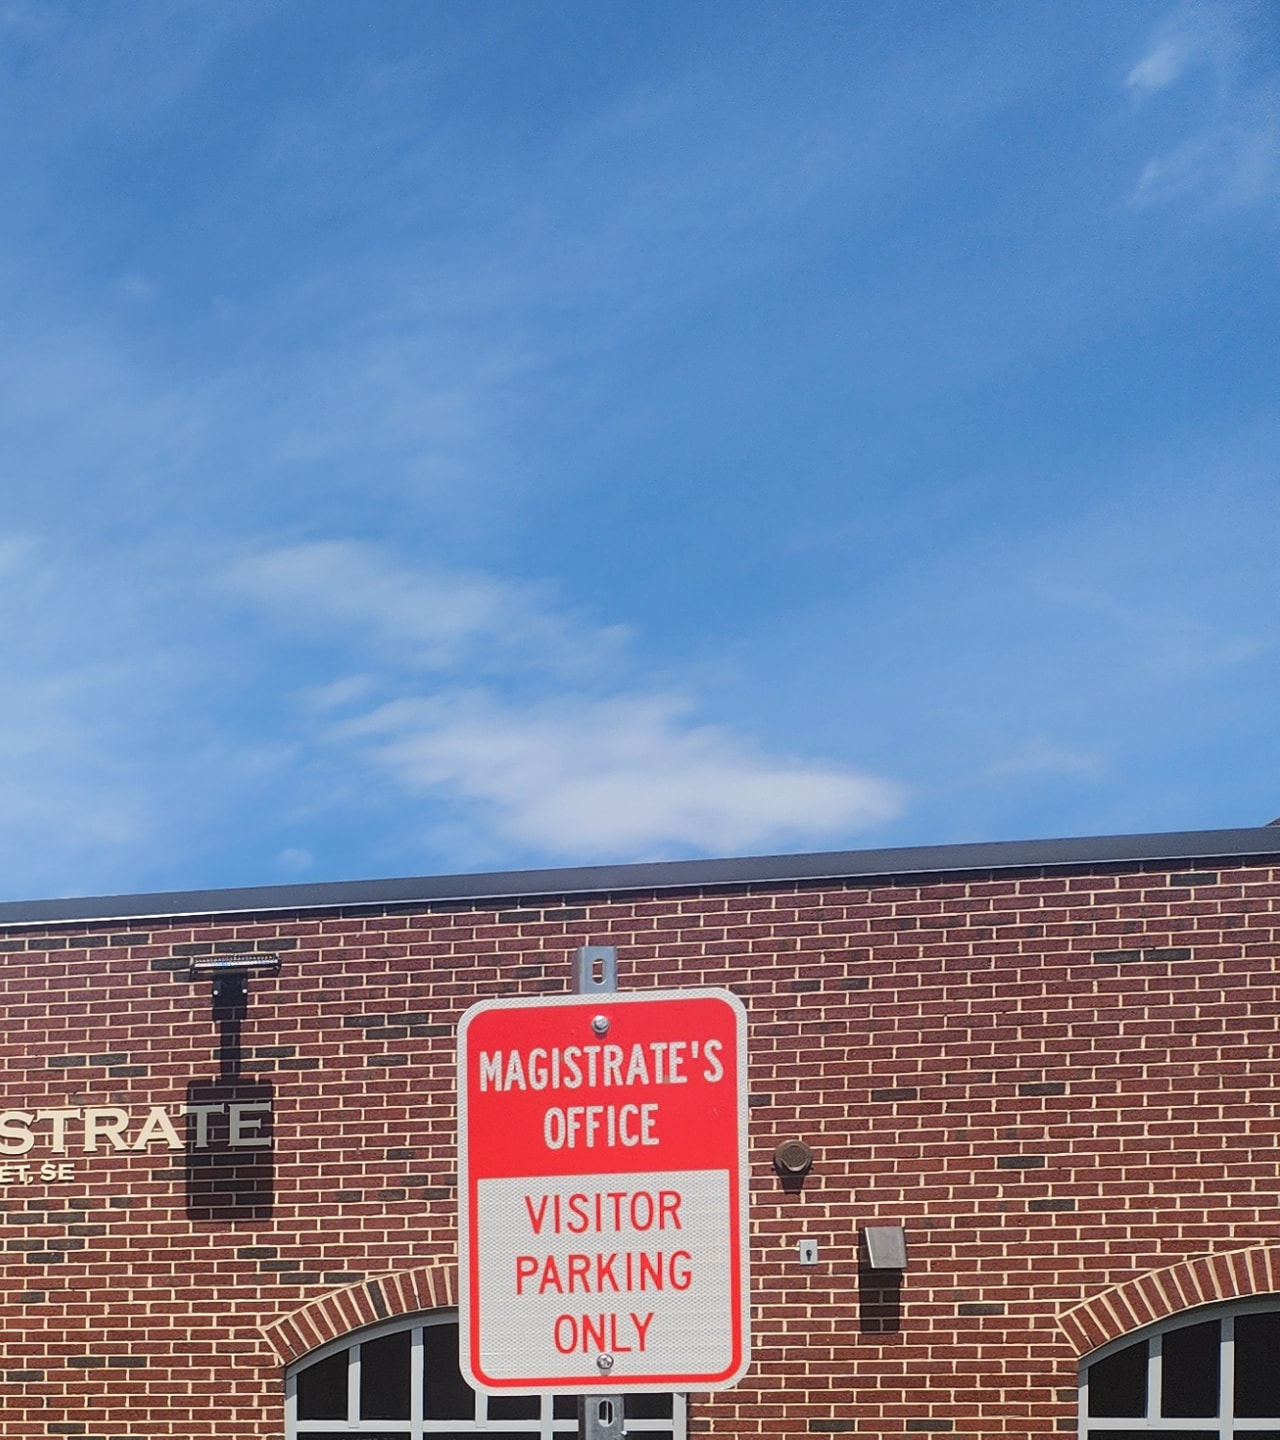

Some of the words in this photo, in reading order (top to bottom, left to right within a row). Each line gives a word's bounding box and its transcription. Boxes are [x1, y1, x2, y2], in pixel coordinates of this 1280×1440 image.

[479, 1039, 724, 1092] MAGISTRATE'S
[543, 1103, 660, 1150] OFFICE
[40, 1163, 75, 1181] SE
[524, 1190, 683, 1235] VISITOR
[515, 1250, 693, 1295] PARKING
[554, 1312, 655, 1355] ONLY
